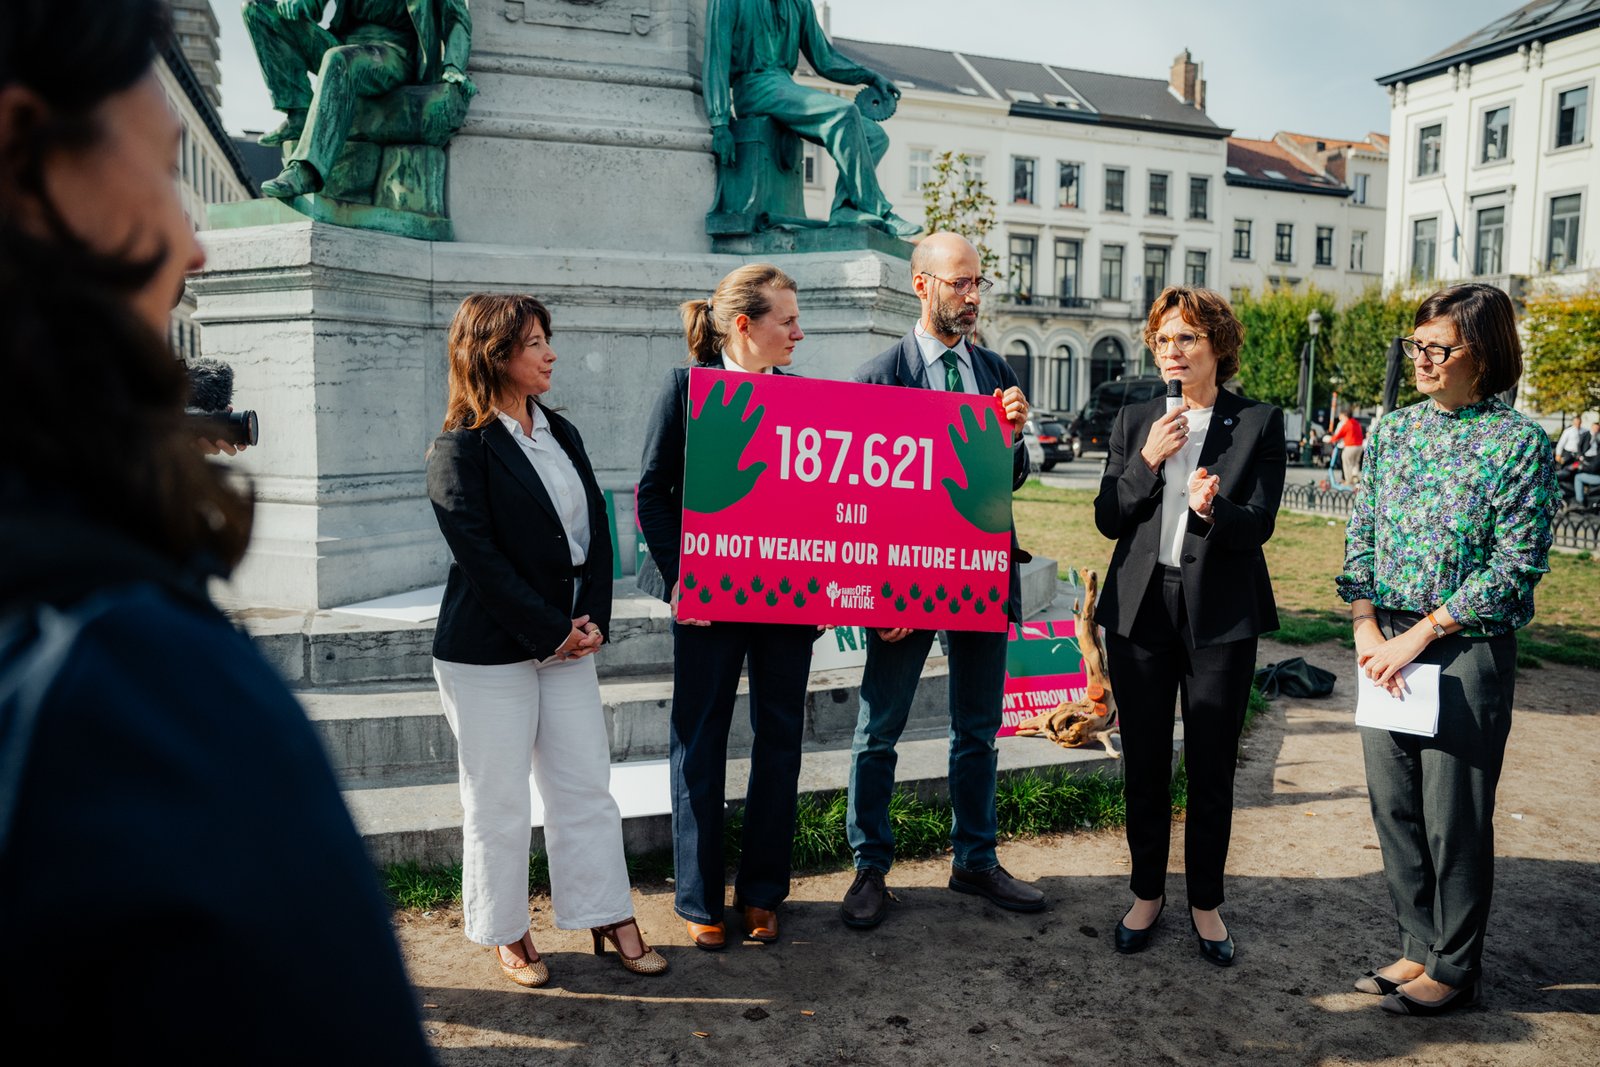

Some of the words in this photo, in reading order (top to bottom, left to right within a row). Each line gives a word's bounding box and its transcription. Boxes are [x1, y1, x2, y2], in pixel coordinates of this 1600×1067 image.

[776, 425, 933, 490] 187.621
[836, 503, 867, 524] SAID
[683, 532, 710, 556] DO
[715, 534, 754, 558] NOT
[758, 536, 836, 563] WEAKEN
[841, 541, 879, 565] OUR
[888, 544, 956, 569] NATURE
[960, 549, 1008, 572] LAWS
[855, 585, 872, 596] OFF
[841, 595, 875, 609] NATURE
[1025, 688, 1068, 707] THROW
